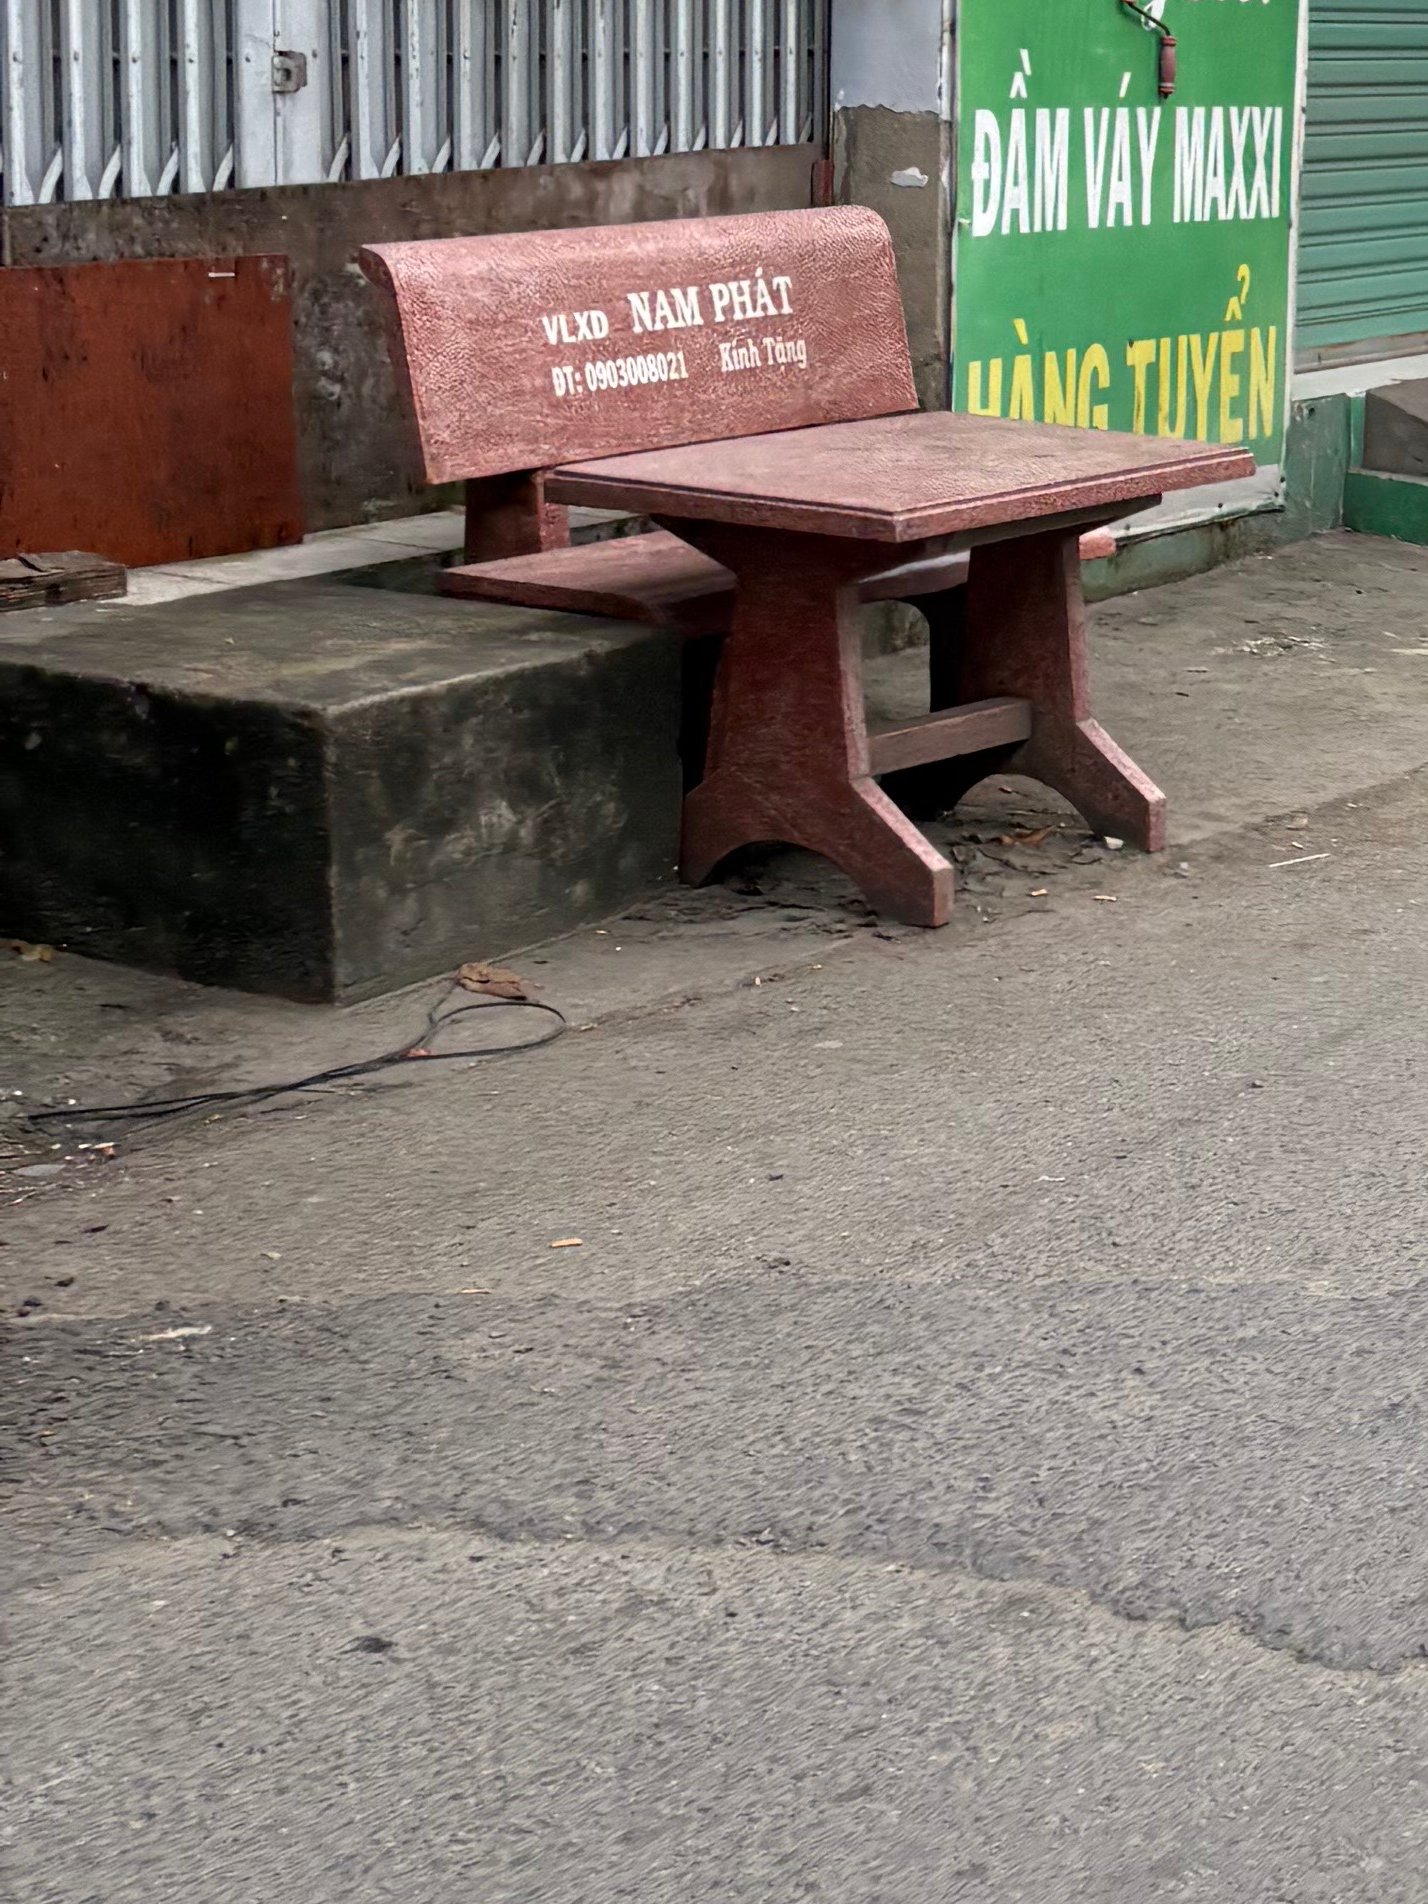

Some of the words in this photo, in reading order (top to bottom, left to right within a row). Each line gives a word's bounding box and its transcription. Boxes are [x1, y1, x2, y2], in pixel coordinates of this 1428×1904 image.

[971, 48, 1070, 237] ĐẦM
[1083, 72, 1161, 228] VÁY
[1173, 107, 1282, 223] MAXXI
[541, 310, 609, 345] VLXD
[627, 286, 704, 333] NAM
[709, 266, 793, 323] PHÁT
[551, 365, 583, 396] ĐT:
[584, 351, 688, 392] 0903008021
[719, 335, 761, 372] Kính
[762, 336, 807, 373] Tặng
[1126, 263, 1276, 444] TUYỂN
